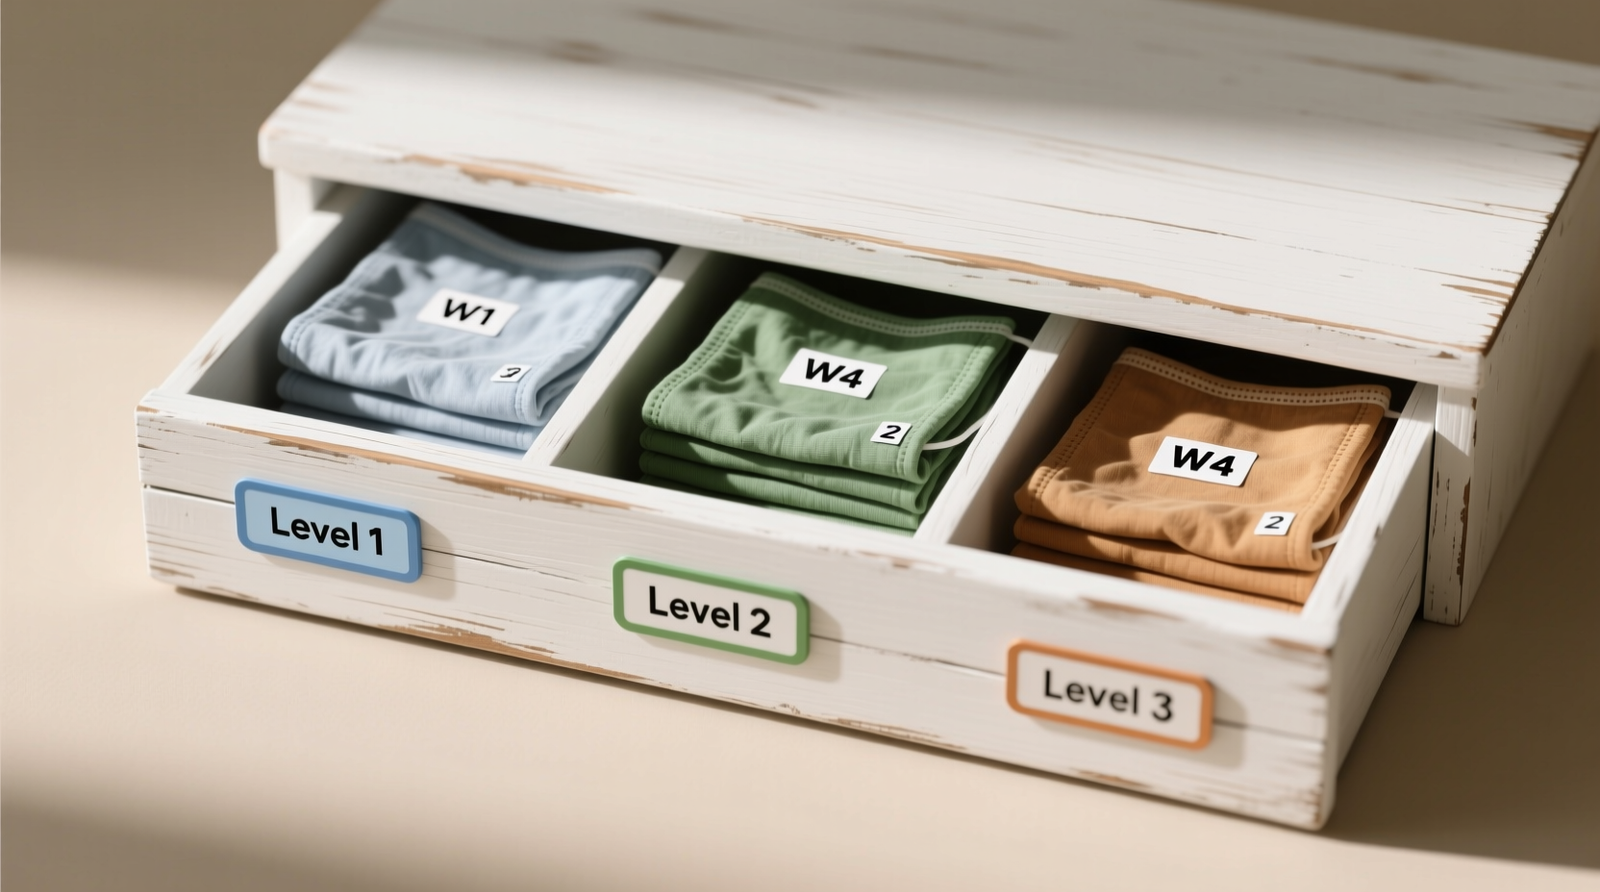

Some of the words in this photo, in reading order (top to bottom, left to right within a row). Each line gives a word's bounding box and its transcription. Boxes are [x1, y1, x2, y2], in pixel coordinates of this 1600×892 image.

[444, 298, 495, 325] W1
[805, 358, 864, 389] W4
[879, 425, 902, 440] 2
[1173, 445, 1236, 477] W4
[270, 506, 359, 552] Level
[368, 527, 383, 556] 1
[1264, 515, 1284, 530] 2
[649, 586, 740, 632] Level
[750, 607, 771, 638] 2
[1044, 669, 1139, 715] Level
[1152, 692, 1173, 723] 3
